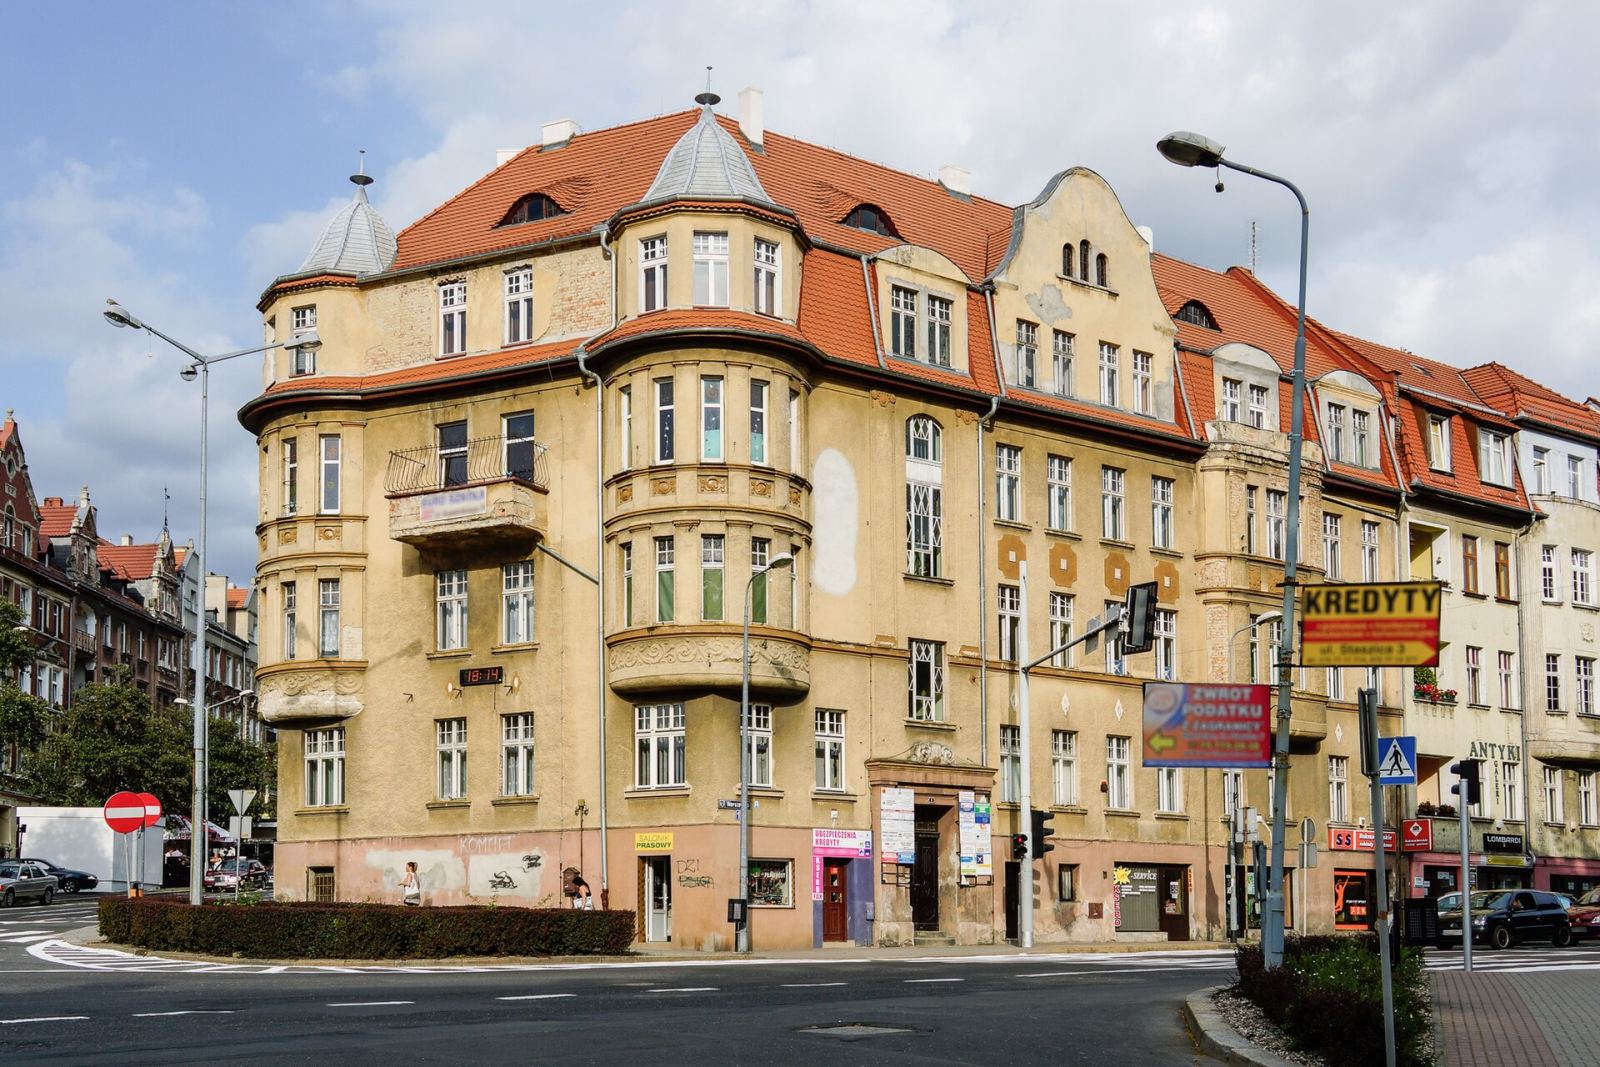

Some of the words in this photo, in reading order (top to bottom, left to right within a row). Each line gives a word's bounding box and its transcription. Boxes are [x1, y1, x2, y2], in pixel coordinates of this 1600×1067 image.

[1305, 588, 1438, 614] KREDYTY
[467, 669, 499, 682] 18:14
[1193, 687, 1252, 699] ZWROT
[1182, 703, 1263, 717] PODATKU
[1469, 741, 1521, 761] ANTYKI
[815, 830, 857, 839] UBEZPIECZENIA
